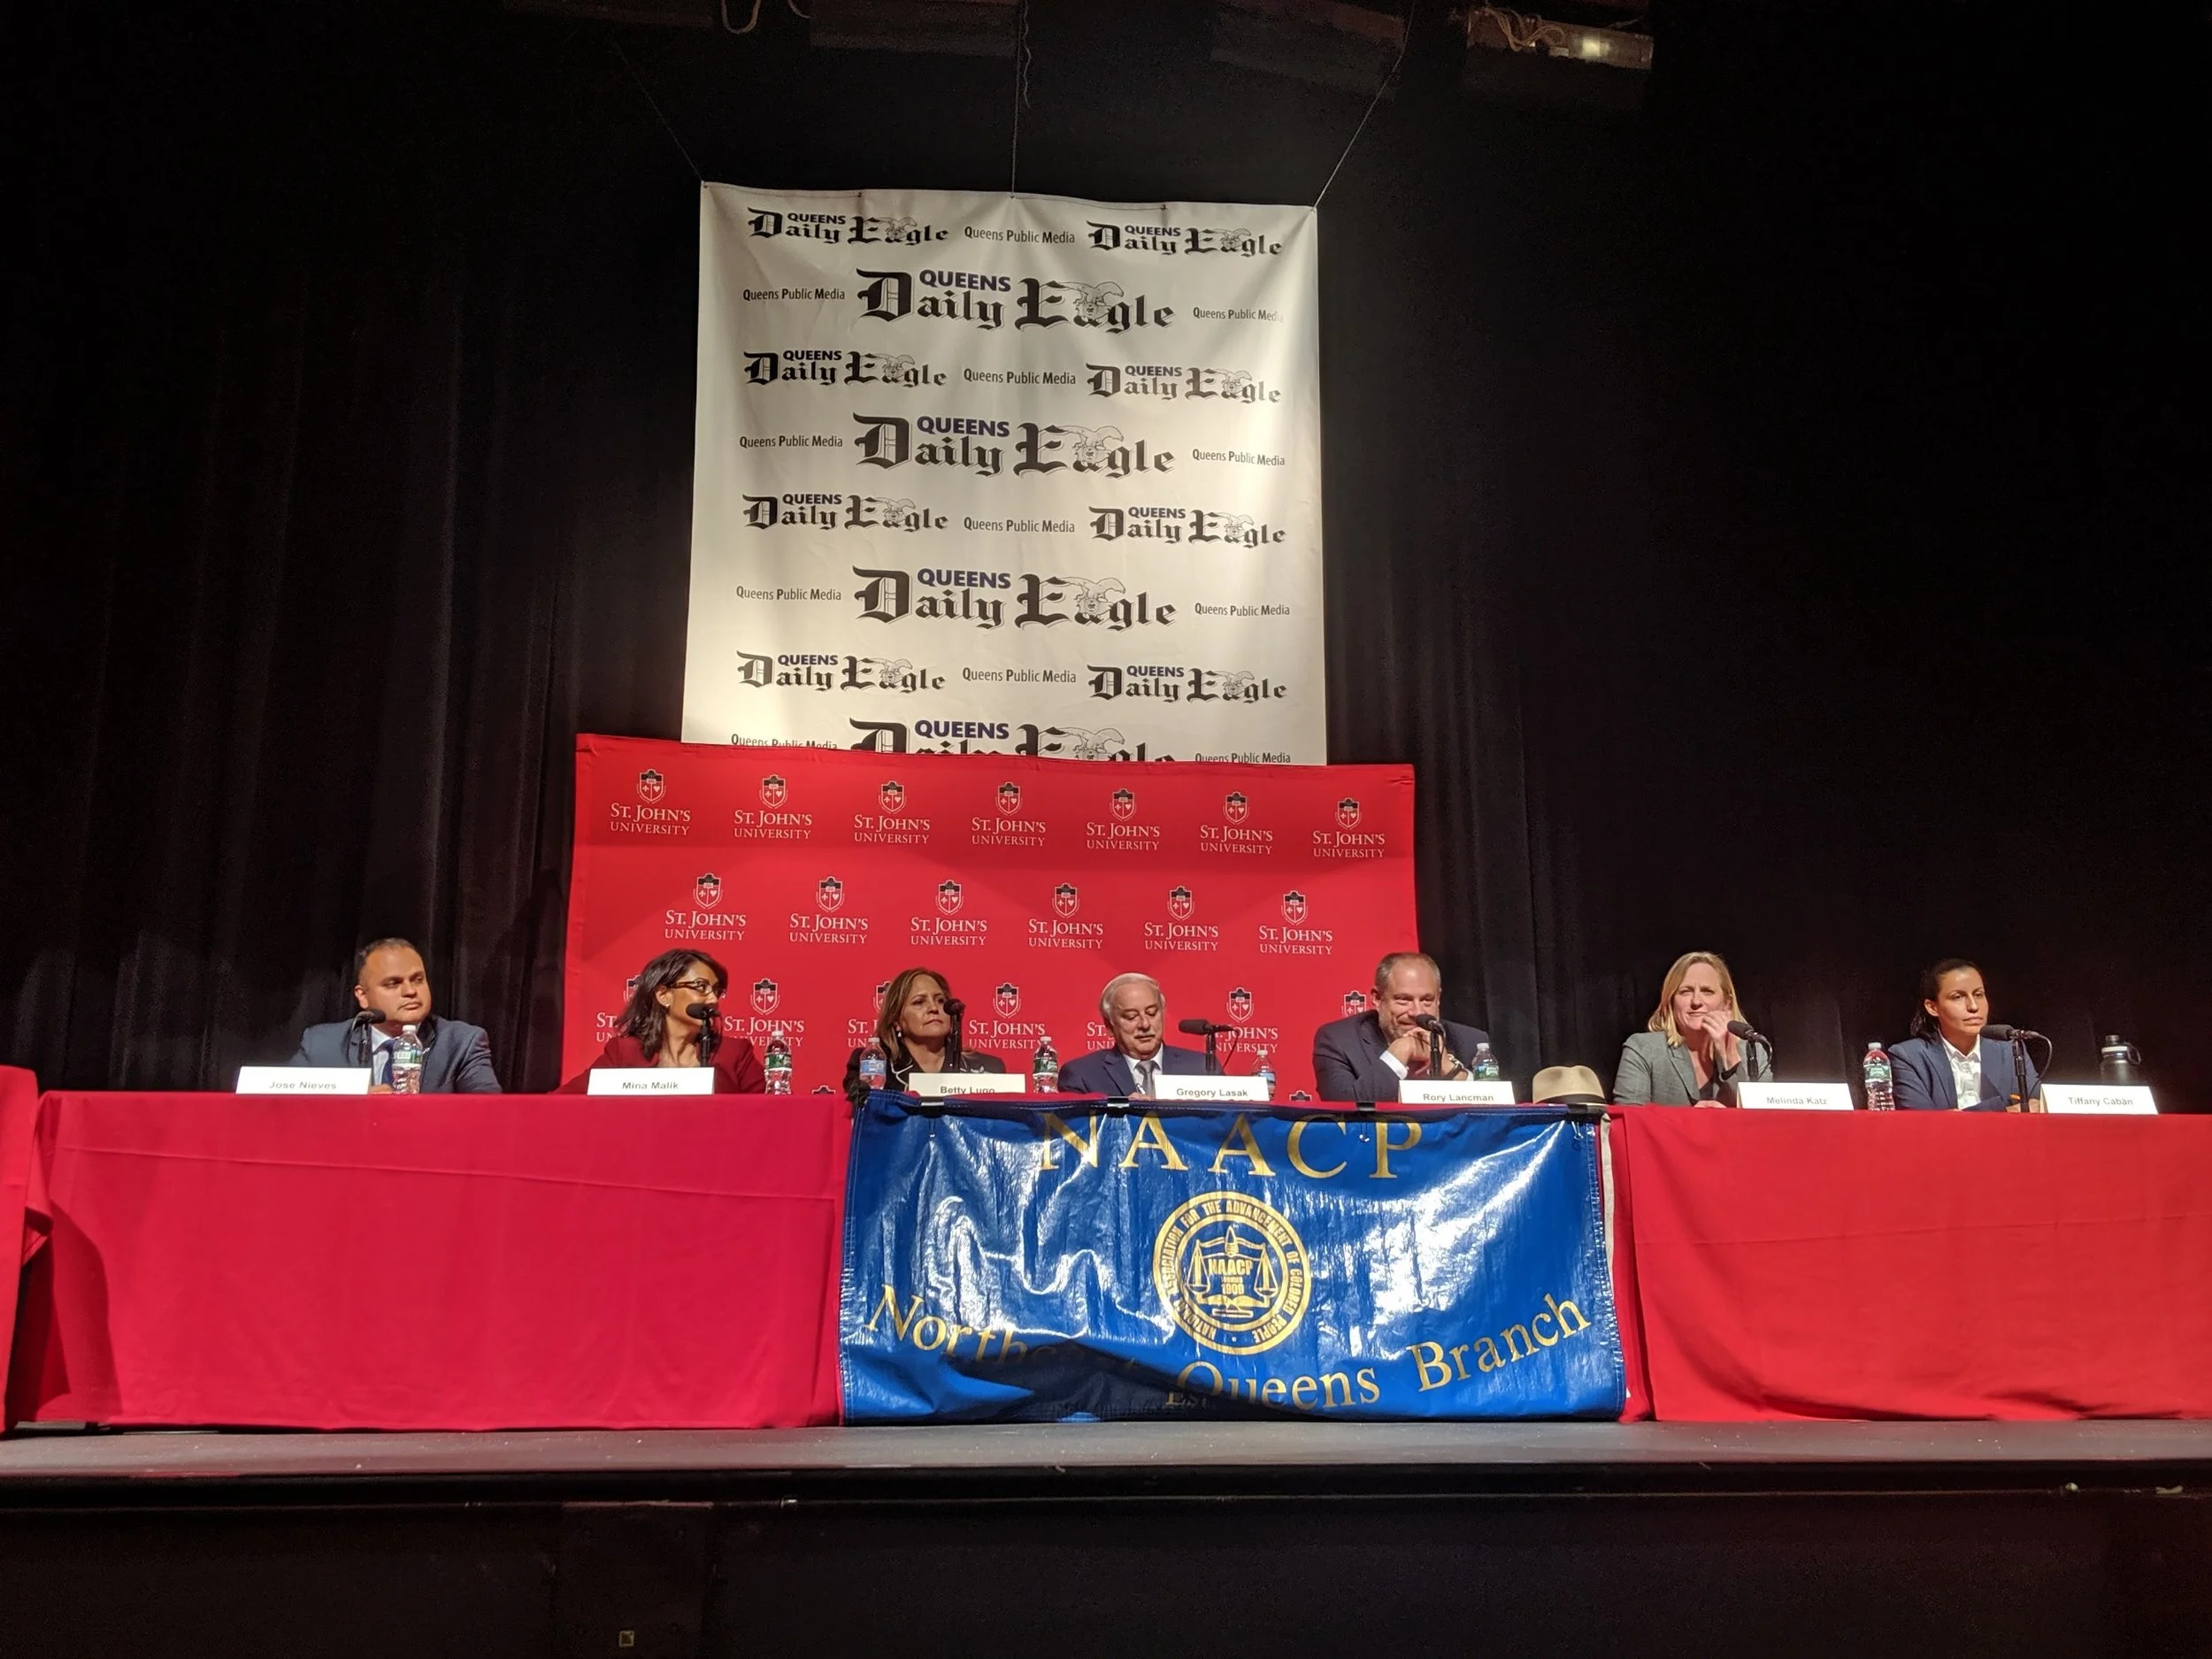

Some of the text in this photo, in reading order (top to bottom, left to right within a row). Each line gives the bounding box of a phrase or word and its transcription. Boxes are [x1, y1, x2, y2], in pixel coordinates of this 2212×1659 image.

[748, 207, 949, 246] Daily Eagle
[787, 212, 846, 225] QUEENS
[964, 226, 1075, 243] Queens Public Media
[1087, 220, 1283, 257] Daily Eagle
[1125, 225, 1181, 237] QUEENS
[919, 269, 1010, 291] QUEENS
[743, 288, 845, 302] Queens Public Media
[856, 267, 1175, 334] Daily Eagle
[1193, 307, 1225, 320] Queens
[1228, 309, 1256, 320] Public
[783, 349, 841, 361] QUEENS
[743, 350, 947, 388] Daily Eagle
[964, 369, 1076, 385] Queens Public Media
[1125, 365, 1182, 377] QUEENS
[1086, 363, 1281, 403] Daily Eagle
[917, 416, 1010, 437] QUEENS
[740, 435, 842, 449] Queens Public Media
[853, 412, 1175, 479] Daily Eagle
[1193, 449, 1285, 466] Queens Public Media
[782, 494, 841, 505] QUEENS
[742, 494, 949, 533] Daily Eagle
[1128, 506, 1186, 518] QUEENS
[964, 517, 1075, 533] Queens Public Media
[1088, 506, 1286, 549] Daily Eagle
[918, 568, 1010, 589] QUEENS
[736, 586, 841, 601] Queens Public Media
[852, 565, 1179, 632] Daily Eagle
[1194, 603, 1290, 616] Queens Public Media
[778, 654, 838, 665] QUEENS
[736, 650, 946, 693] Daily Eagle
[963, 667, 1076, 683] Queens Public Media
[1126, 665, 1184, 677] QUEENS
[1087, 664, 1287, 703] Daily Eagle
[915, 719, 1010, 739] QUEENS
[1232, 752, 1259, 764] Public
[1262, 752, 1291, 763] Media
[611, 803, 691, 823] ST. JOHN'S
[734, 810, 812, 828] ST. JOHN'S
[610, 822, 690, 835] UNIVERSITY
[854, 814, 930, 833] ST. JOHN'S
[972, 817, 1046, 835] ST. JOHN'S
[1087, 822, 1160, 839] ST. JOHN'S
[734, 827, 812, 840] UNIVERSITY
[854, 833, 930, 844] UNIVERSITY
[972, 834, 1045, 847] UNIVERSITY
[1200, 826, 1273, 843] ST. JOHN'S
[1313, 831, 1386, 848] ST. JOHN'S
[1087, 839, 1159, 850] UNIVERSITY
[1200, 842, 1272, 855] UNIVERSITY
[1313, 848, 1385, 858] UNIVERSITY
[664, 910, 747, 929] ST. JOHN'S
[789, 913, 869, 932] ST. JOHN'S
[910, 917, 987, 935] ST. JOHN'S
[1028, 919, 1103, 937] ST. JOHN'S
[664, 929, 745, 941] UNIVERSITY
[789, 932, 867, 944] UNIVERSITY
[1144, 922, 1219, 940] ST. JOHN'S
[1259, 926, 1333, 944] ST. JOHN'S
[910, 934, 987, 946] UNIVERSITY
[1028, 938, 1103, 949] UNIVERSITY
[1145, 939, 1218, 951] UNIVERSITY
[1260, 944, 1333, 955] UNIVERSITY
[725, 1017, 804, 1035] ST. JOHN'S
[969, 1020, 1045, 1038] ST. JOHN'S
[1216, 1042, 1278, 1053] NIVERSITY
[1177, 1088, 1216, 1097] Gregory
[1424, 1094, 1446, 1102] Rory
[2069, 1097, 2100, 1106] Tiffany
[1039, 1111, 1423, 1179] NAACP
[1202, 1201, 1221, 1215] THE
[1180, 1209, 1200, 1228] FOR
[1226, 1201, 1292, 1247] ADVANCEMENT
[1286, 1251, 1300, 1264] OF
[1209, 1258, 1253, 1275] NAACP
[1283, 1268, 1302, 1315] COLORED
[1252, 1313, 1287, 1343] PEOPLE
[1406, 1293, 1591, 1393] Branch
